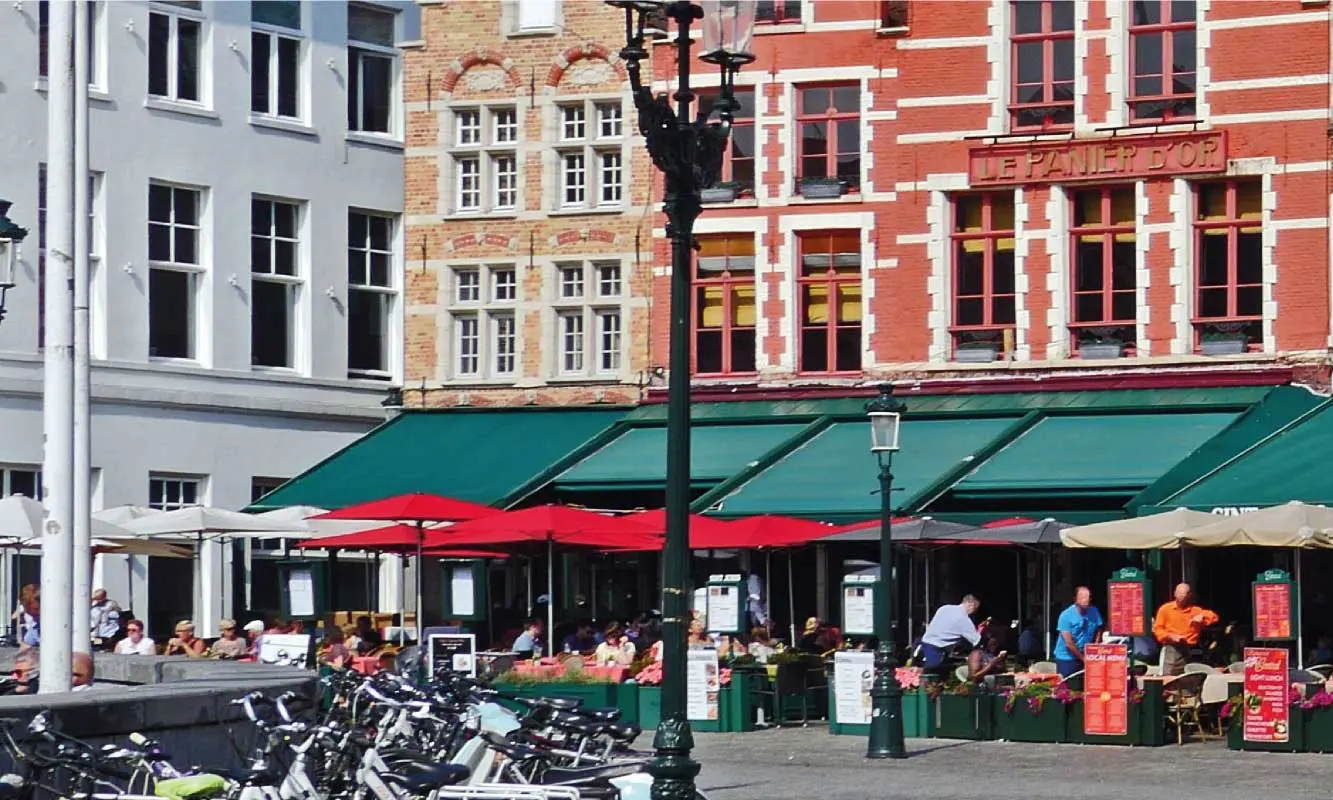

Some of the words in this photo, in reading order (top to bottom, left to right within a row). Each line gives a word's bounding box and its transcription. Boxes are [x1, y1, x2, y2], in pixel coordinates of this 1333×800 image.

[980, 155, 1017, 181] LE
[1025, 144, 1137, 178] PANIER
[1148, 138, 1218, 170] D'OR
